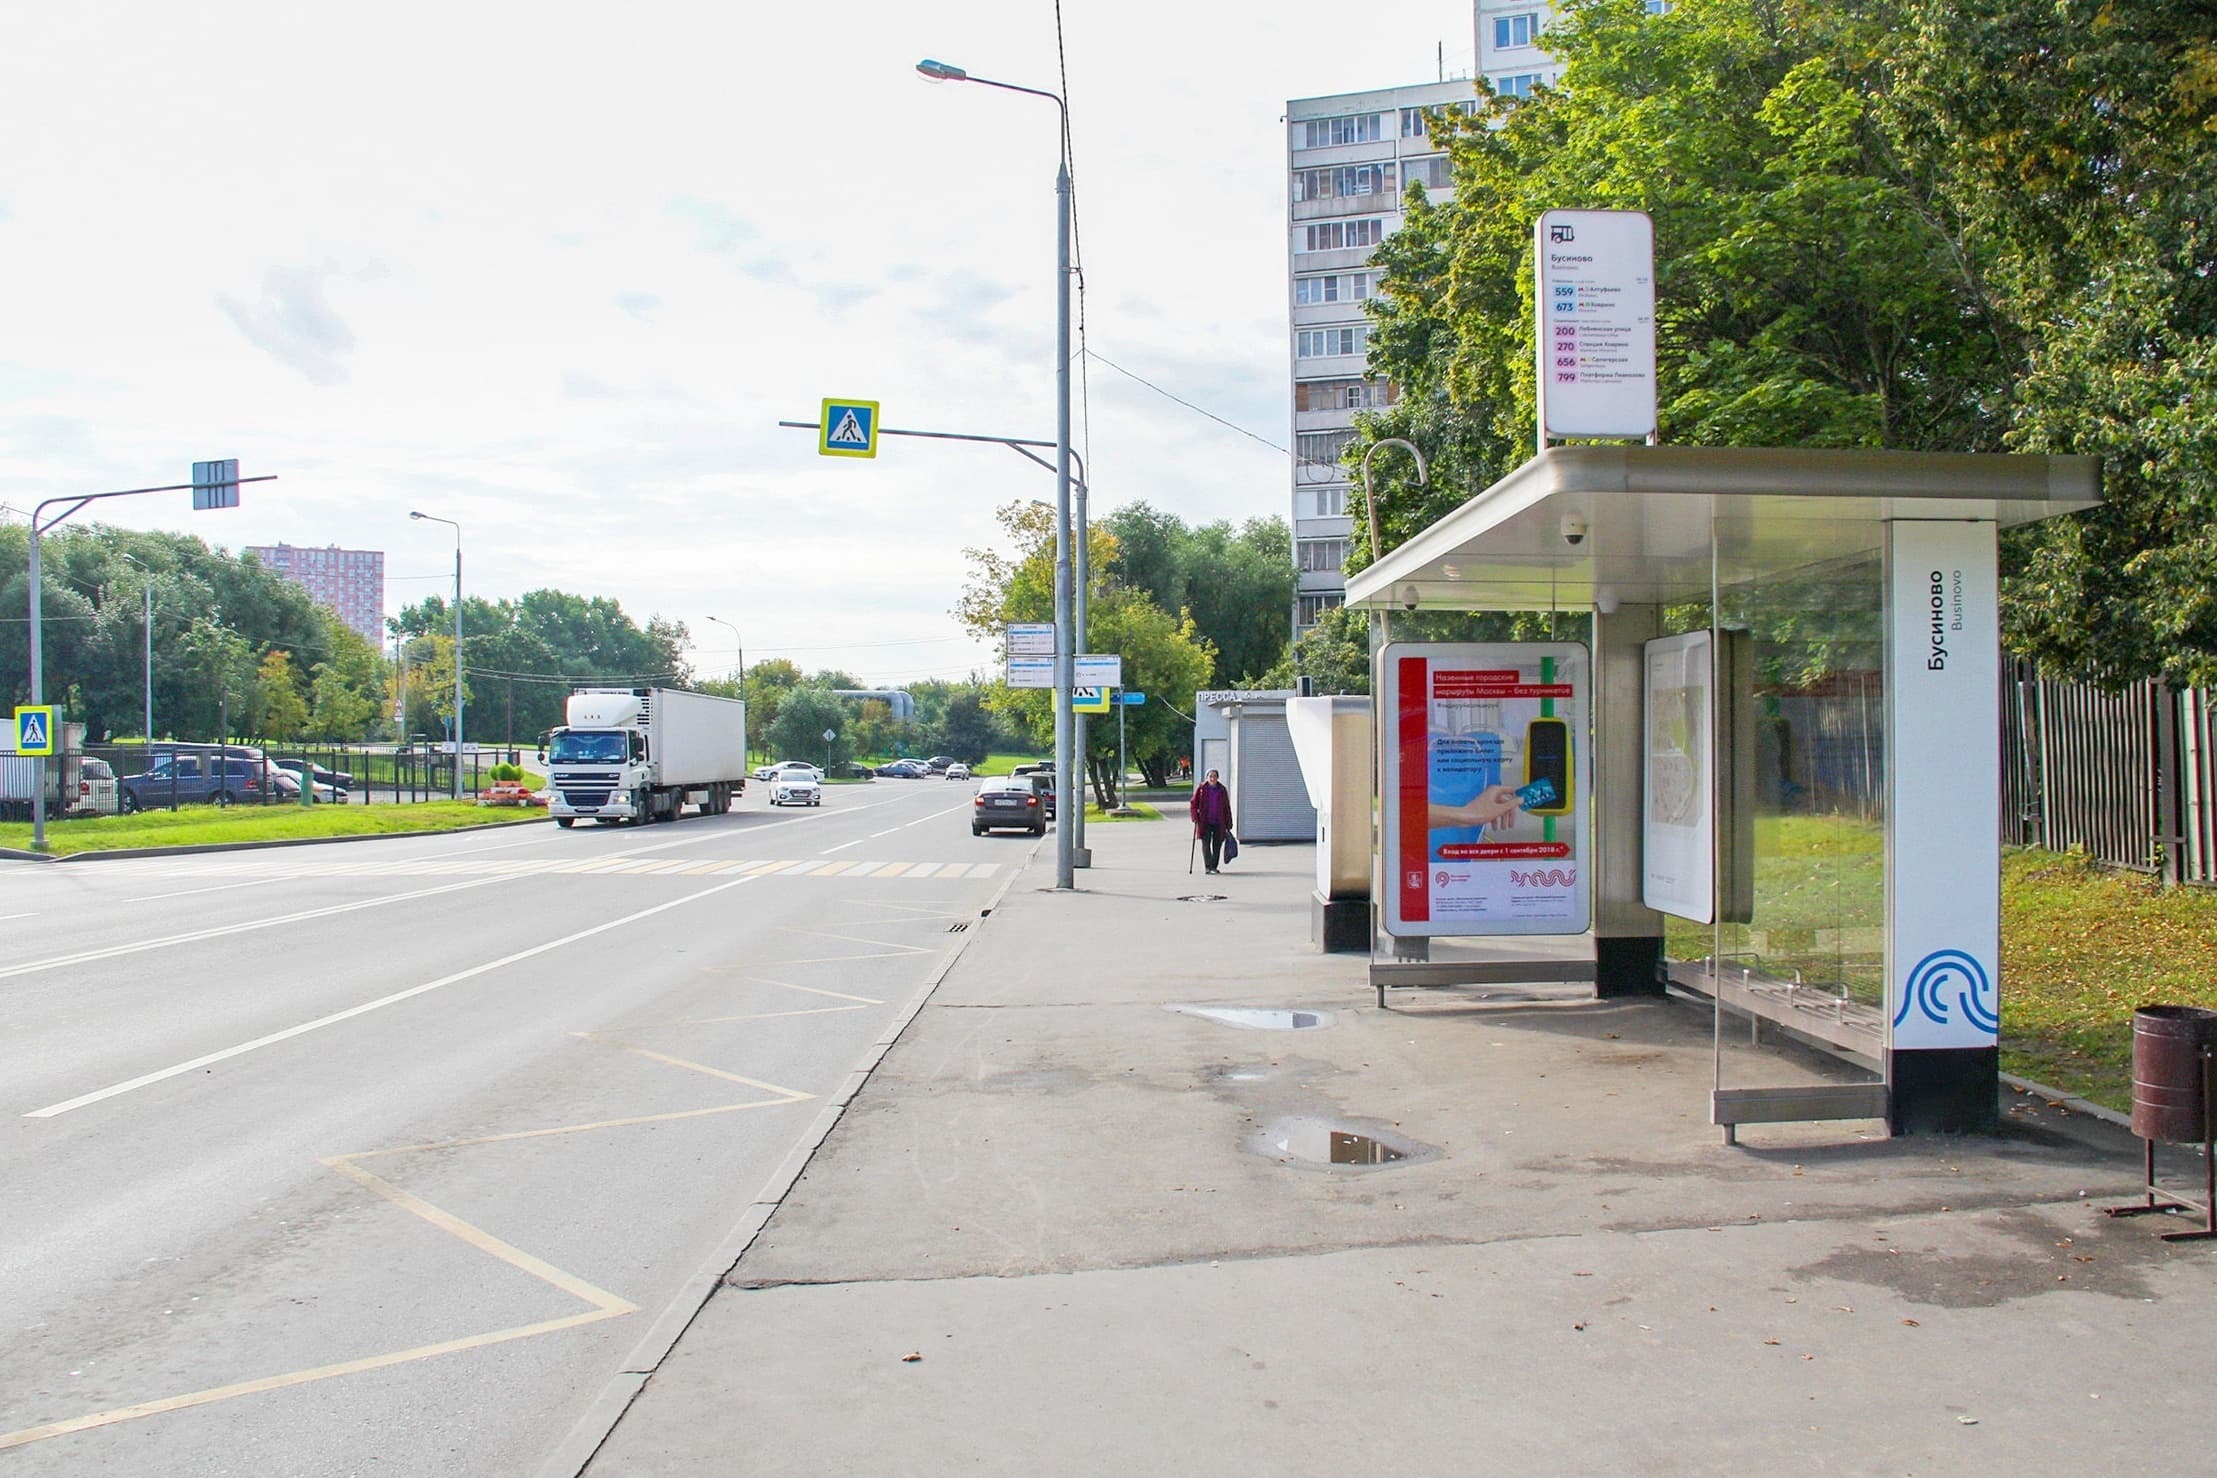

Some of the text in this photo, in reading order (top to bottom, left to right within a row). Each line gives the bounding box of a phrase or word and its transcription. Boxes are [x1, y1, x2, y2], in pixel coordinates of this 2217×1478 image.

[1552, 254, 1592, 262] Бусиново
[1555, 288, 1574, 296] 559
[1556, 303, 1574, 312] 673
[1556, 327, 1575, 336] 200
[1557, 342, 1574, 351] 270
[1557, 358, 1576, 367] 656
[1558, 373, 1576, 382] 799
[1951, 570, 1962, 630] Businovo
[1928, 570, 1948, 670] Бусиново
